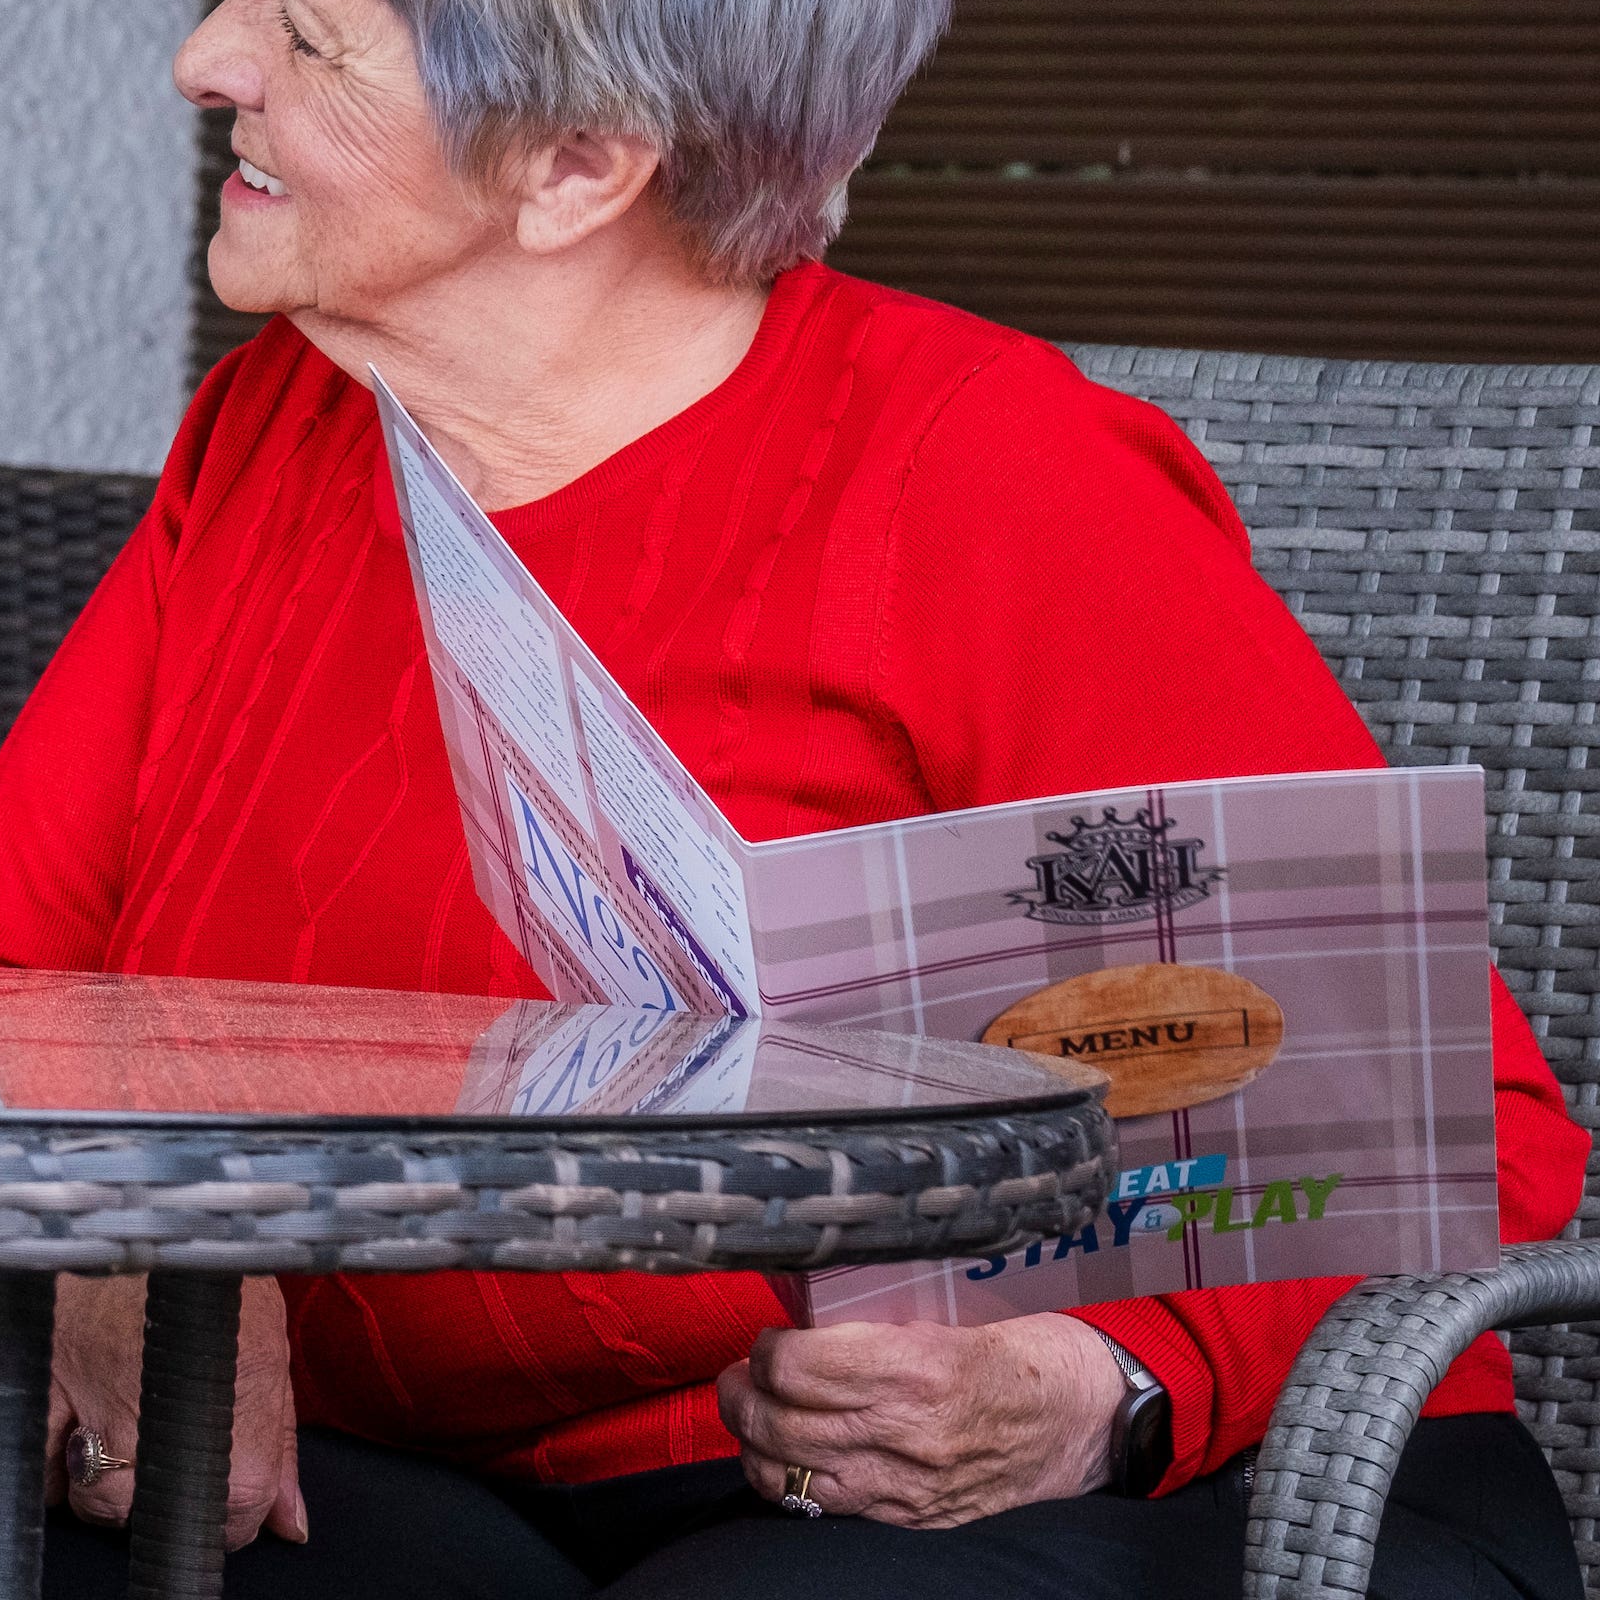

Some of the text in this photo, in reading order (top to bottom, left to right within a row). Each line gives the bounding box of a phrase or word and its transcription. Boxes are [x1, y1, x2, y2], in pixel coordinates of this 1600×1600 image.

[1059, 1020, 1196, 1059] MENU
[1117, 1158, 1198, 1199] EAT
[1166, 1172, 1345, 1243] PLAY
